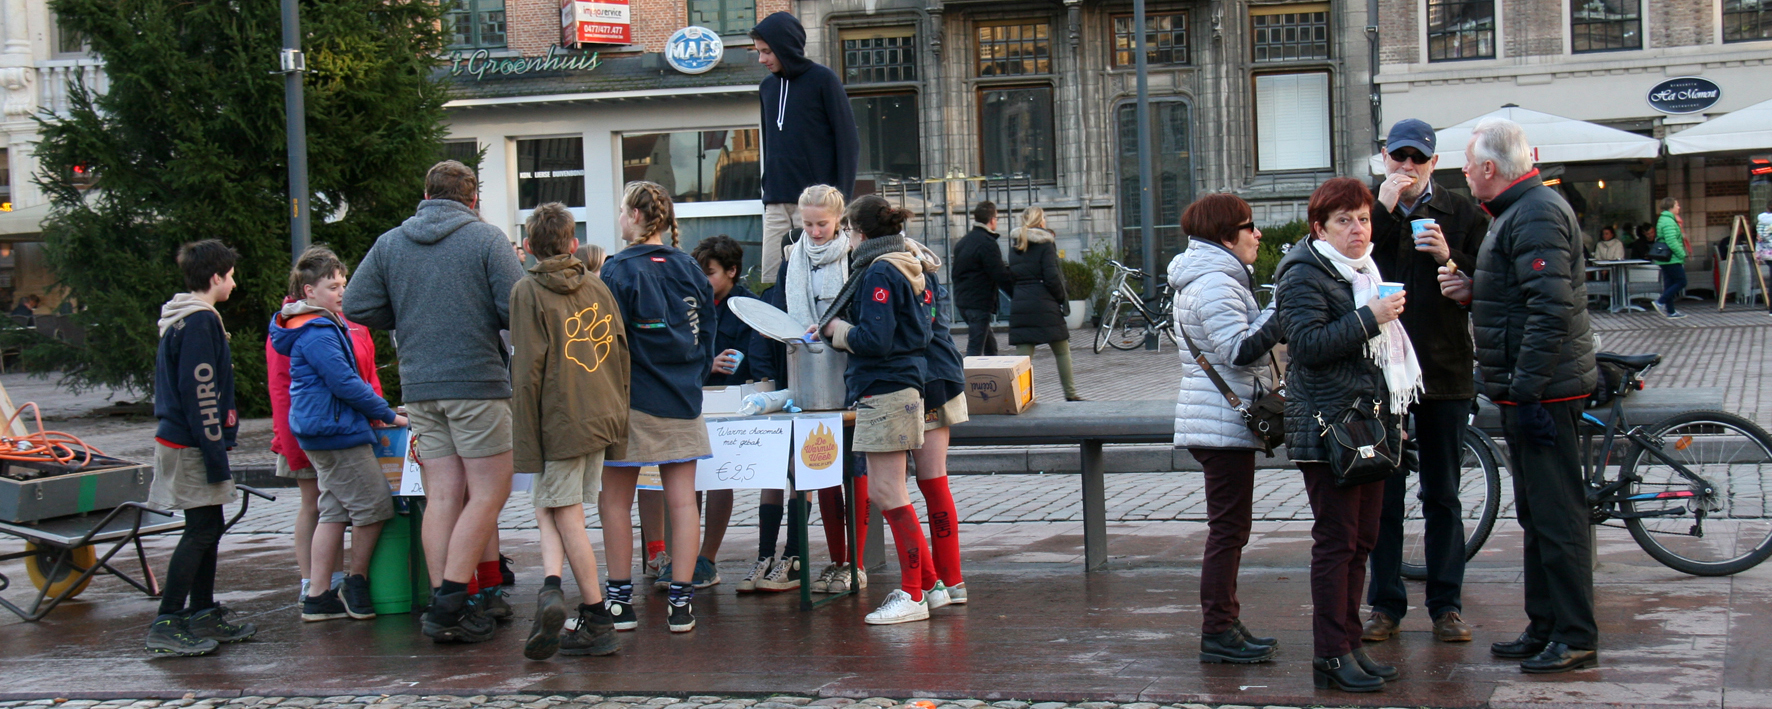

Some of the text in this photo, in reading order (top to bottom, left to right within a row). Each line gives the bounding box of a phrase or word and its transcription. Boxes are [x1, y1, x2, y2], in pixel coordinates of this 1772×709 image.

[668, 40, 720, 61] MAES
[468, 44, 602, 80] Groenhuis
[1651, 88, 1718, 102] Het Moment
[194, 363, 223, 441] CHIRO
[717, 426, 746, 437] Warme
[815, 437, 826, 445] De
[739, 438, 762, 448] gebak
[809, 452, 831, 461] Week
[716, 461, 757, 482] €2,5
[932, 511, 951, 538] CHIRO
[907, 547, 920, 569] CHIRO
